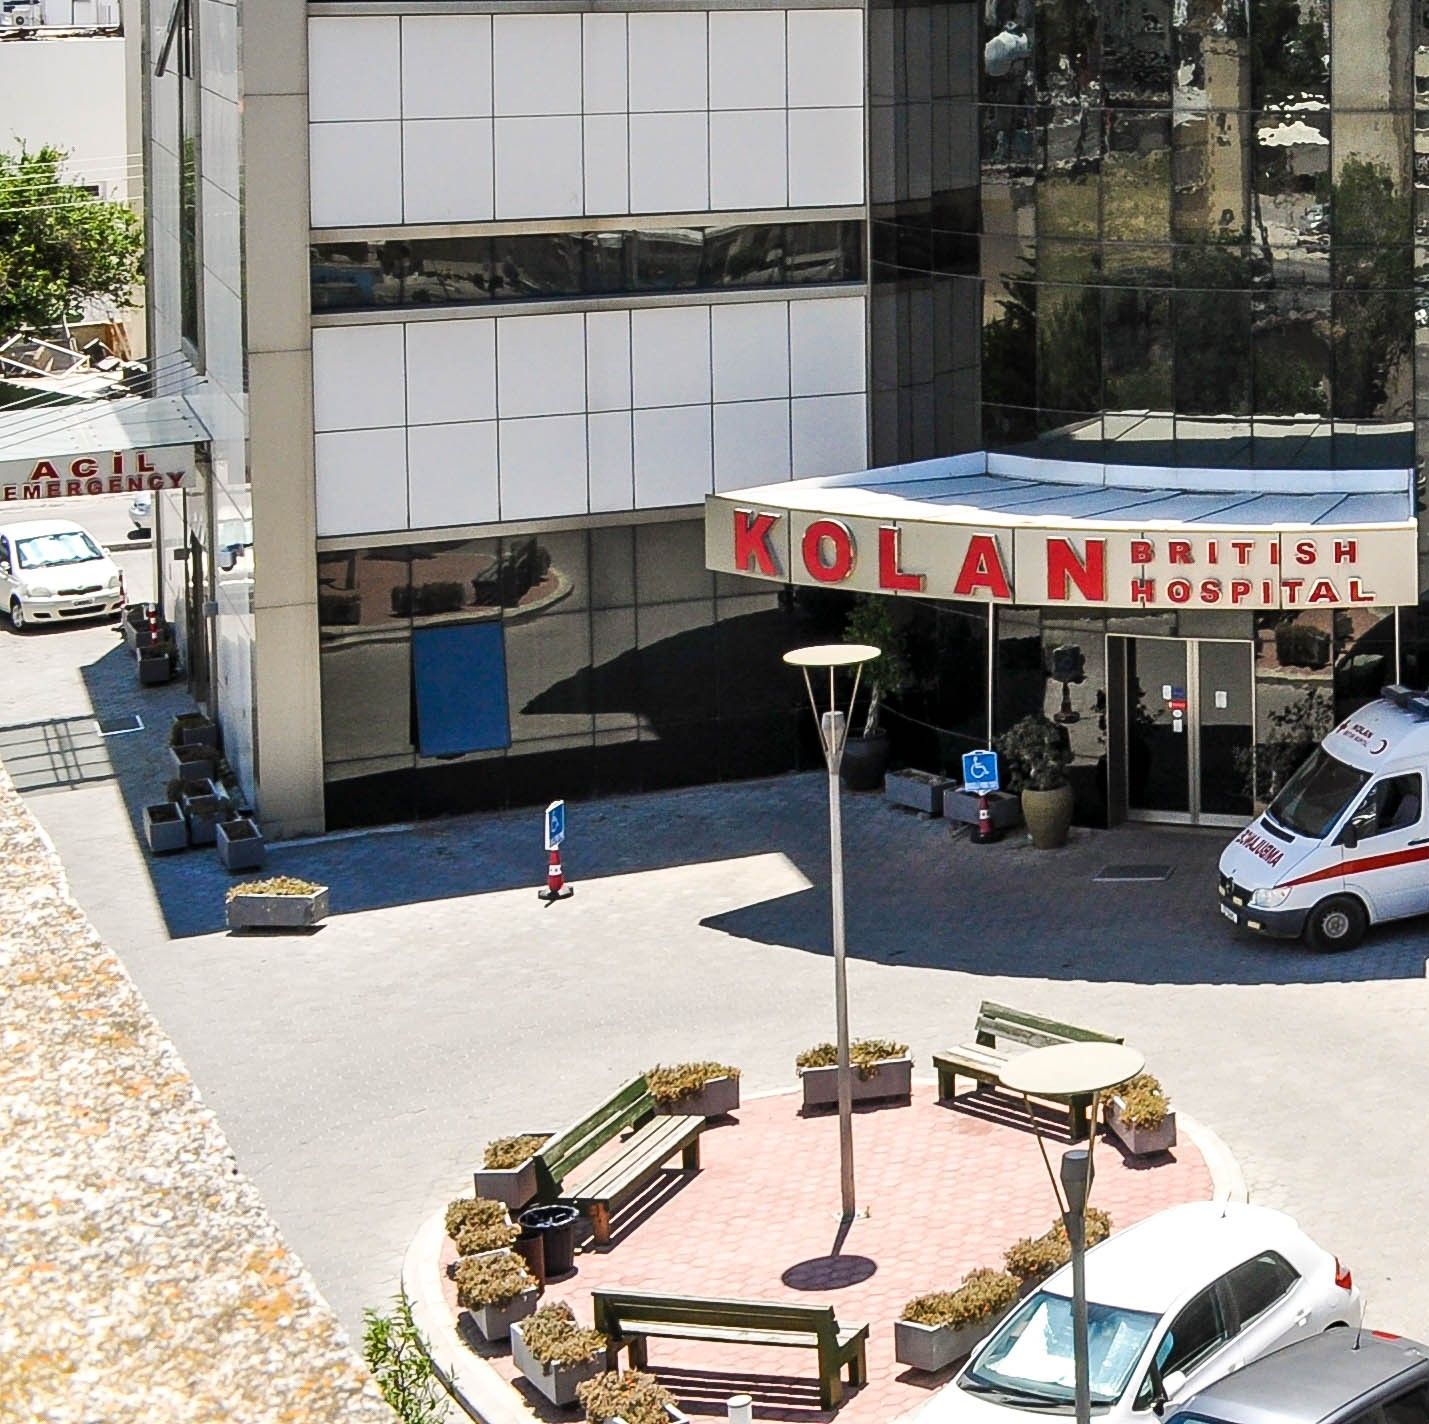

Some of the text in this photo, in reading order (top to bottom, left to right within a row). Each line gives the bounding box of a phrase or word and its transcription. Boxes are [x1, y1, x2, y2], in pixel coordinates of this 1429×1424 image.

[4, 471, 186, 501] EMERGENCY
[733, 508, 1108, 601] KOLAN
[1130, 539, 1359, 565] BRITISH
[1130, 577, 1376, 605] HOSPITAL
